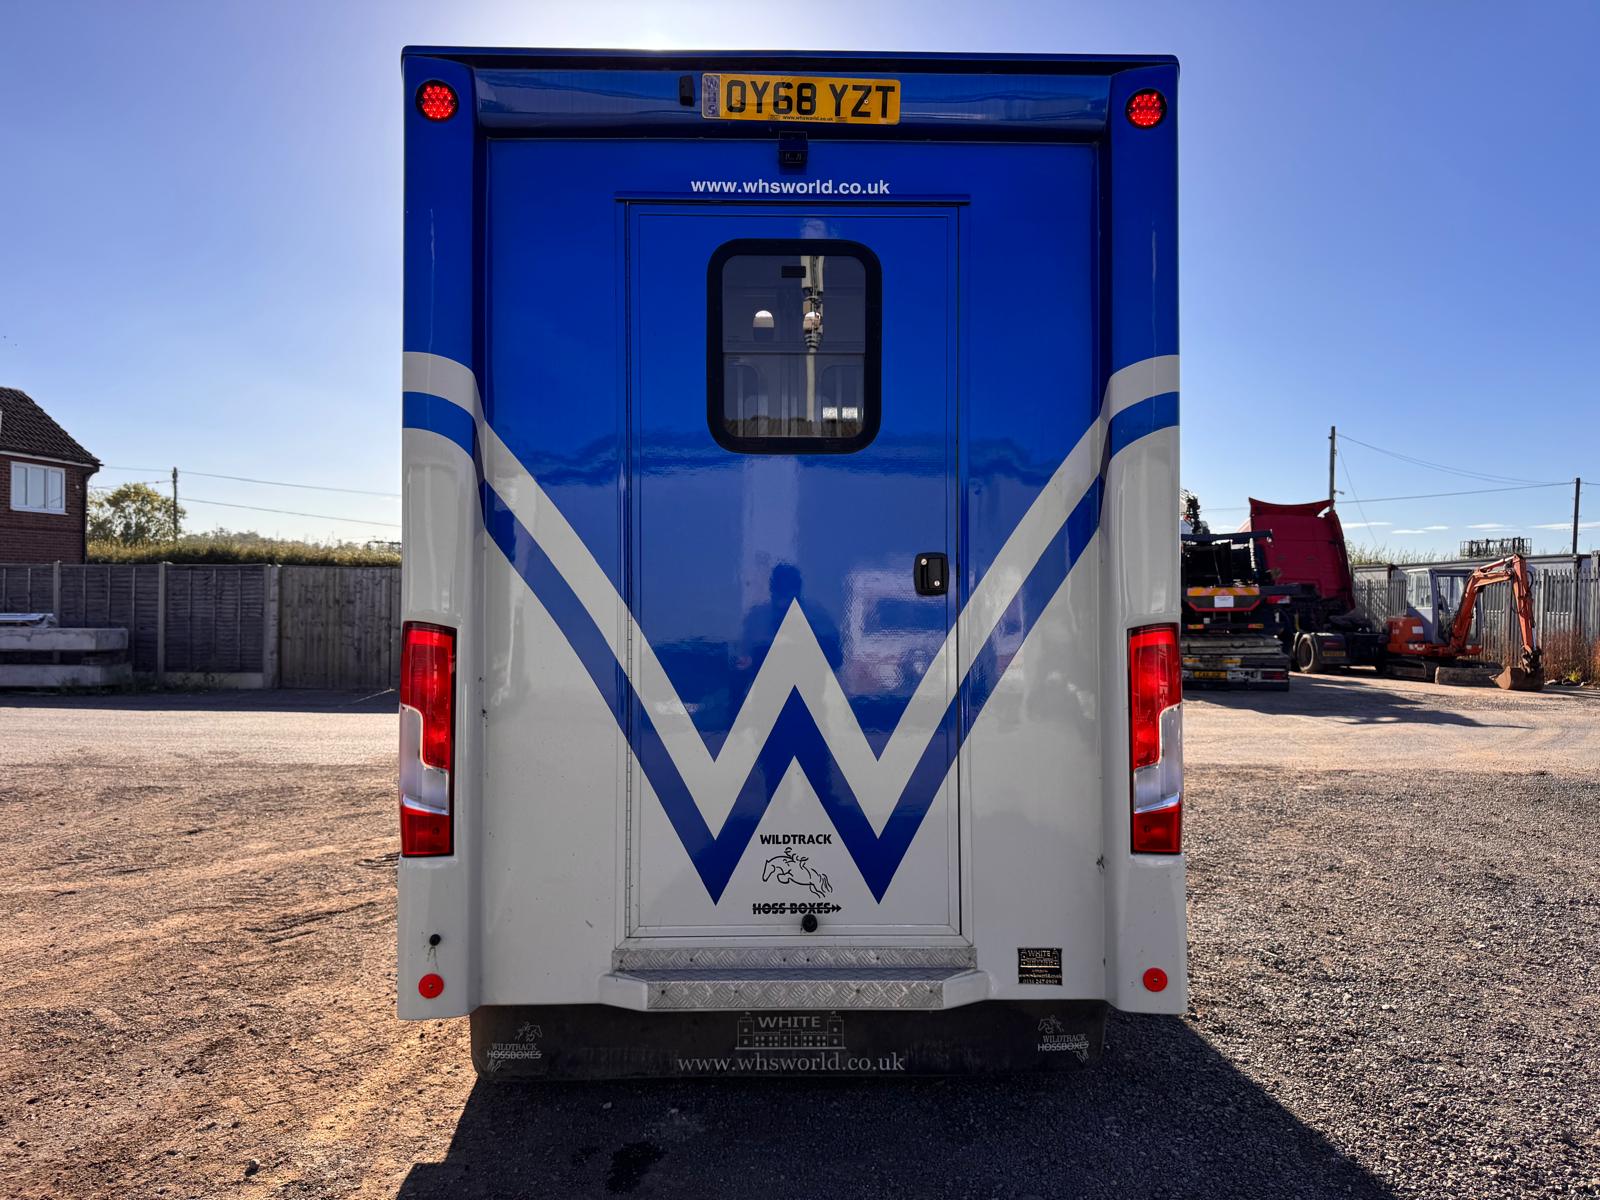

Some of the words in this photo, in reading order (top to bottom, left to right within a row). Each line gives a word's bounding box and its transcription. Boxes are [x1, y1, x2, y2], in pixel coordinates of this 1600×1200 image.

[726, 79, 817, 116] OY68
[829, 83, 896, 119] YZT
[691, 178, 890, 195] www.whsworld.co.uk
[760, 833, 832, 845] WILDTRACK
[752, 902, 786, 914] HOSS
[789, 902, 831, 914] BOXES
[757, 1016, 822, 1028] WHITE
[1043, 1033, 1087, 1043] WILDTRACK
[492, 1043, 537, 1051] WILDTRACK
[678, 1052, 905, 1072] www.whsworld.co.uk
